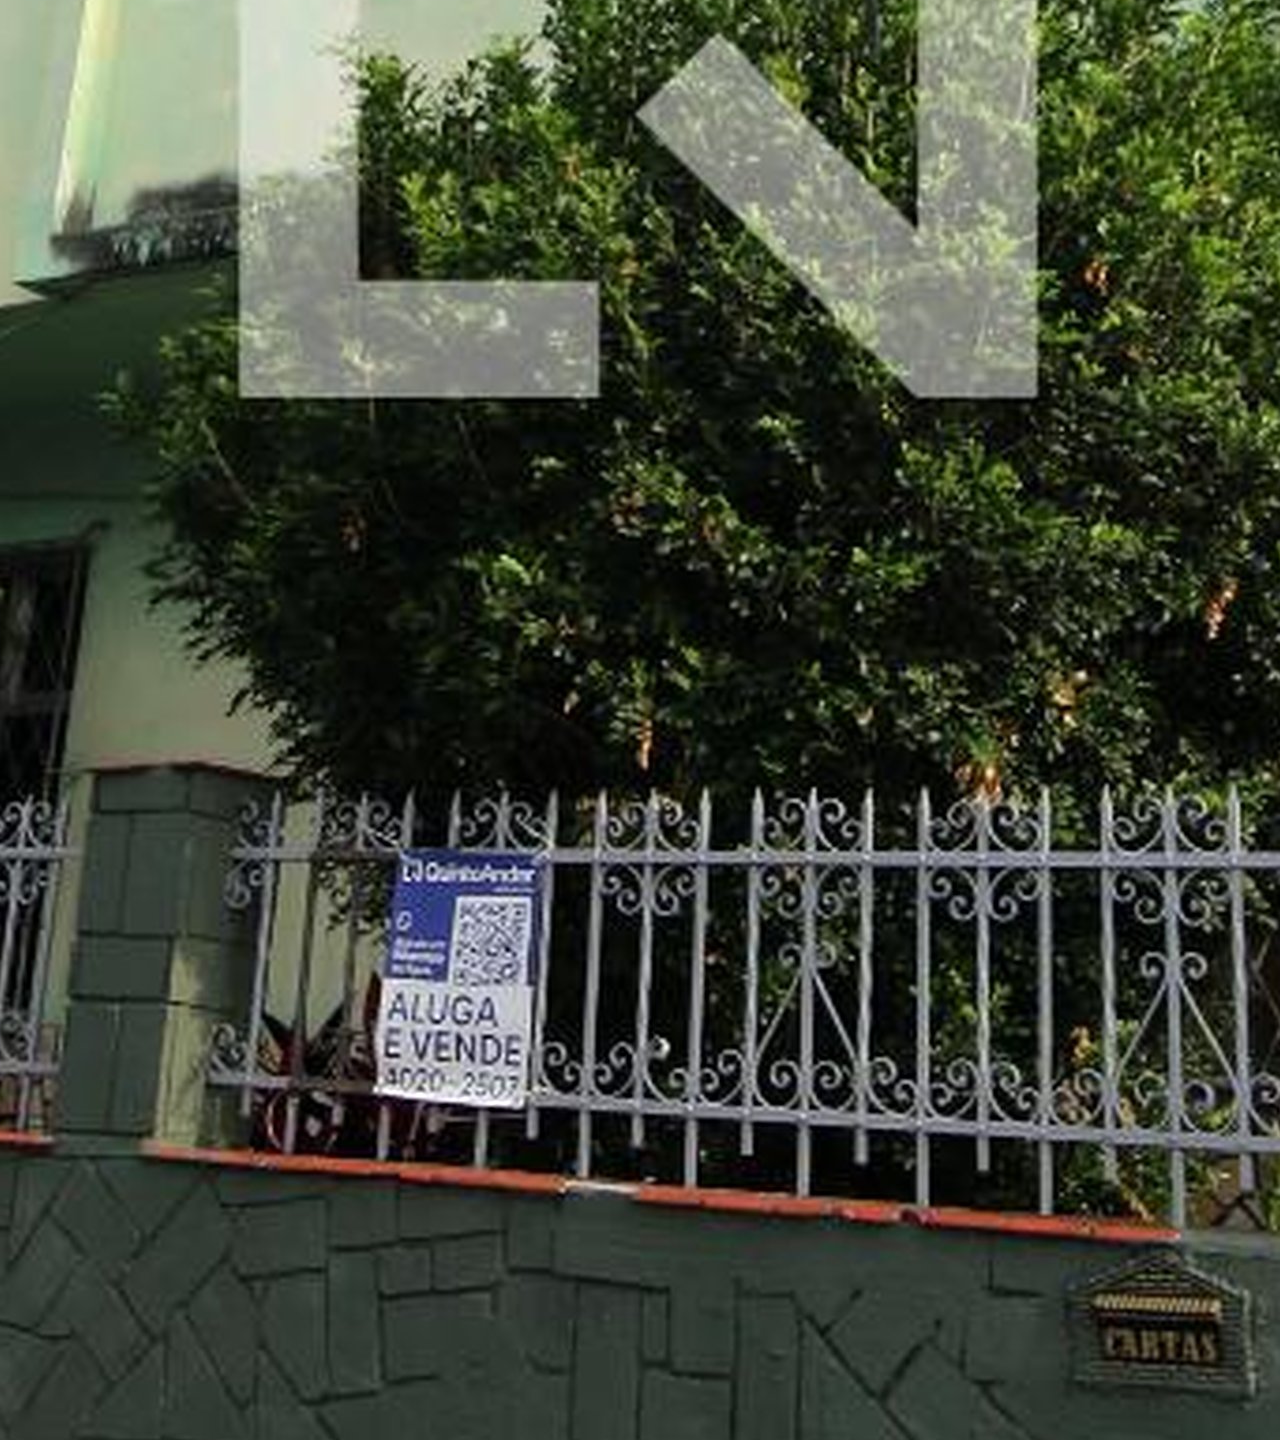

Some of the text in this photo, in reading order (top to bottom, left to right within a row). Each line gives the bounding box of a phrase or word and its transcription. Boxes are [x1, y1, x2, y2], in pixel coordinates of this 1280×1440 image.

[387, 992, 499, 1028] ALUGA
[384, 1028, 521, 1067] E VENDE
[1105, 1327, 1218, 1362] CARTAS
